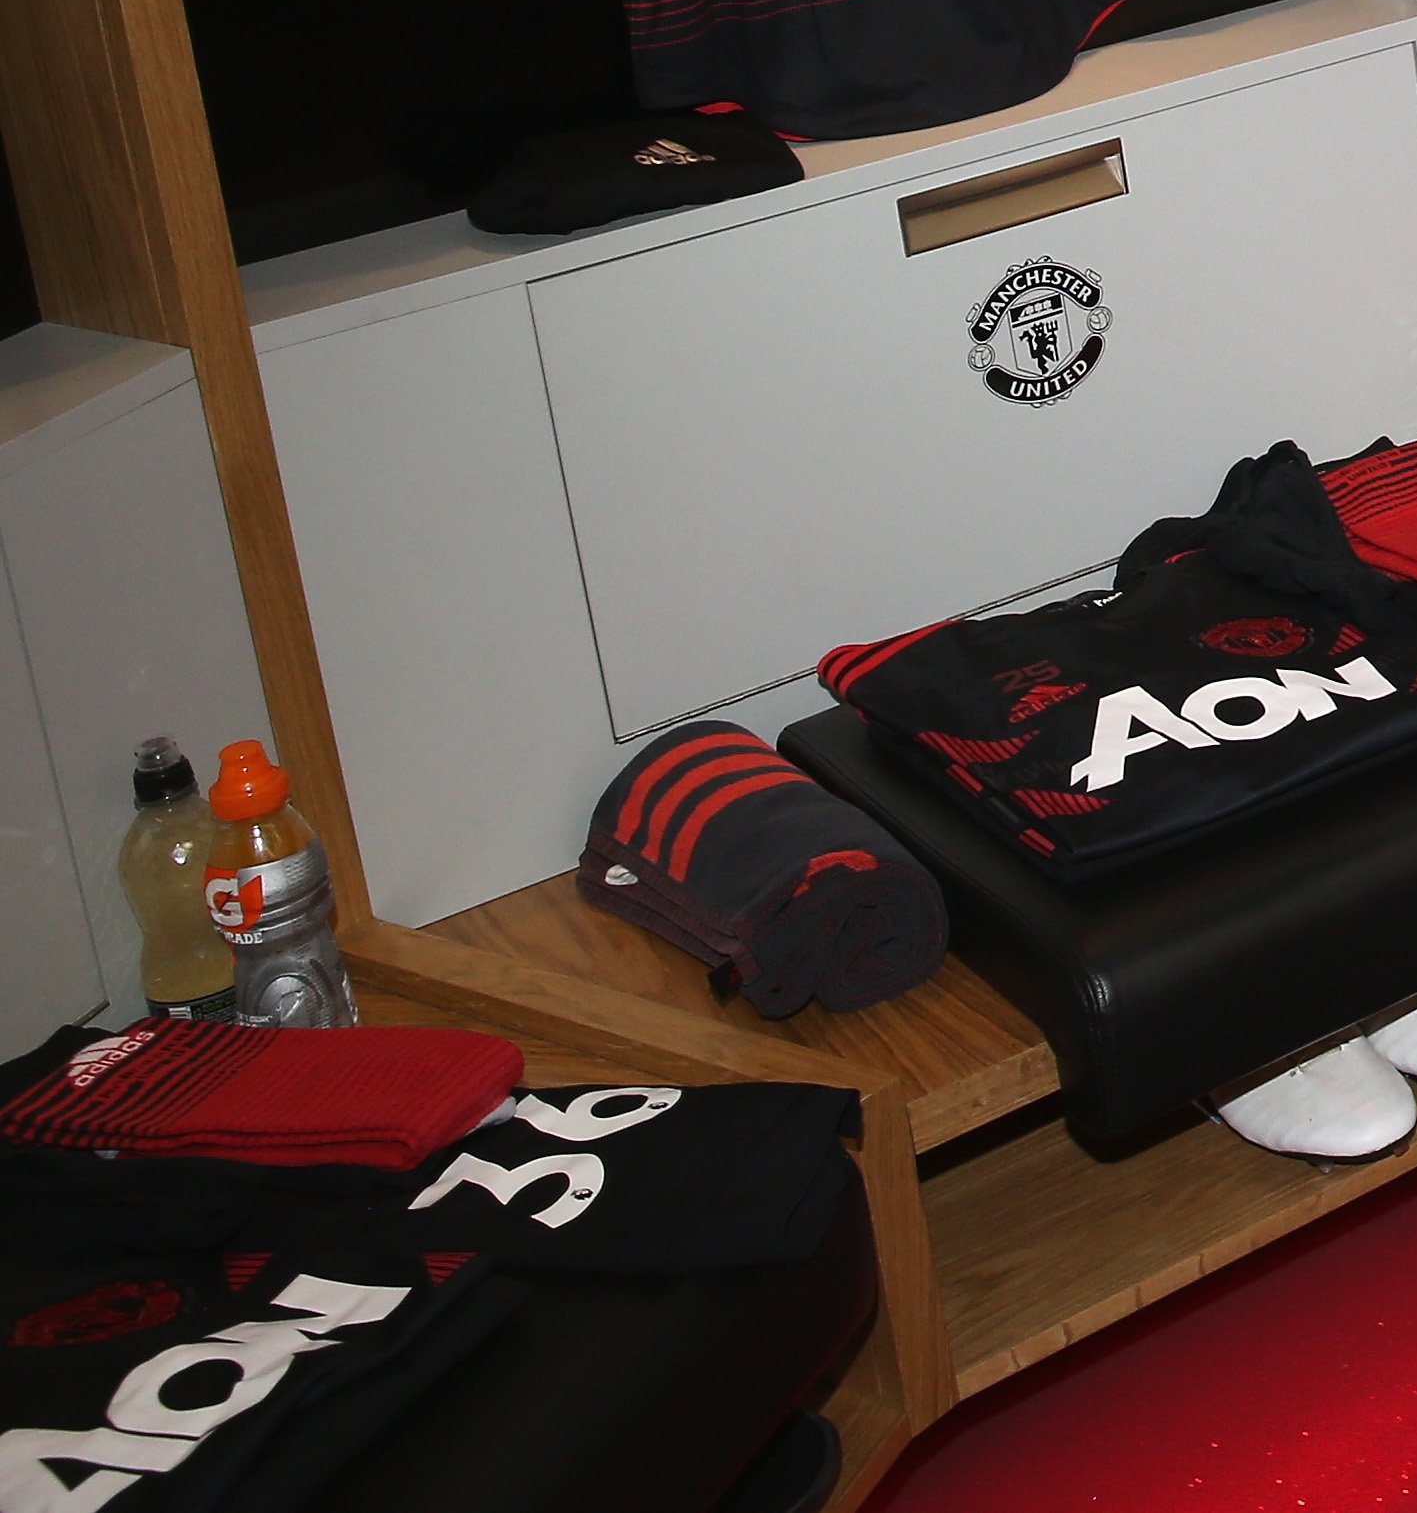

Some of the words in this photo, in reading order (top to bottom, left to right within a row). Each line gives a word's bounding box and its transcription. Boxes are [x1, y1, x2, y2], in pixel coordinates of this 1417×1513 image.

[978, 268, 1092, 332] MANCHESTER
[1010, 359, 1088, 398] UNITED
[1069, 656, 1397, 793] AON
[205, 877, 243, 926] G
[74, 1031, 155, 1087] adidas
[407, 1086, 682, 1229] 36
[0, 1273, 412, 1513] AON
